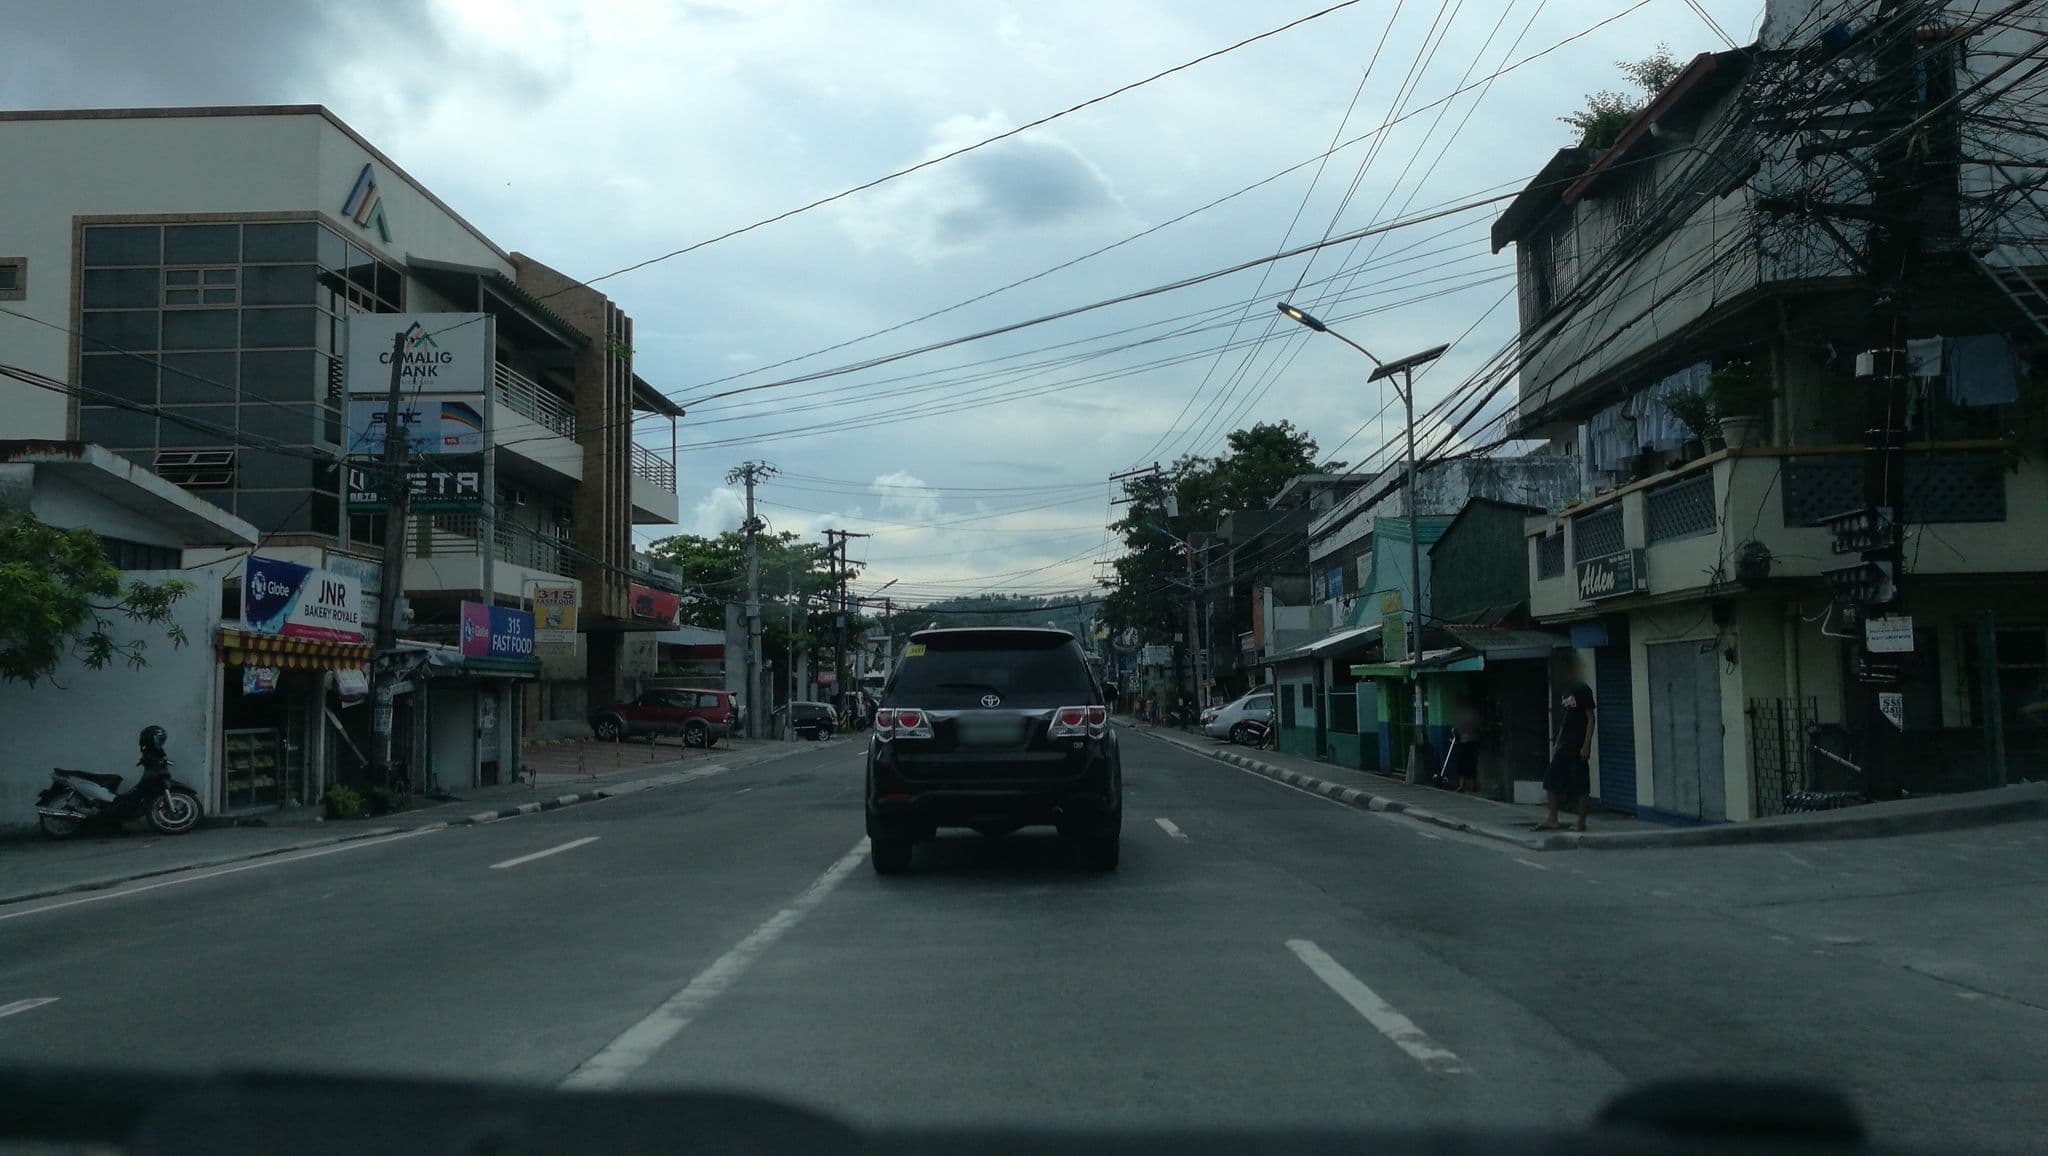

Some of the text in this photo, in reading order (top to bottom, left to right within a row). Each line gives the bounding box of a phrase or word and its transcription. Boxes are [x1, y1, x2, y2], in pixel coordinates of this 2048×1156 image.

[402, 365, 439, 377] ANK
[406, 472, 479, 495] ETA
[267, 581, 290, 597] Globe
[1580, 563, 1615, 600] Alden
[318, 579, 346, 608] JNR
[538, 590, 574, 599] 315
[304, 604, 358, 624] BAKERY ROYALE
[507, 616, 521, 636] 315
[492, 634, 511, 652] FAST
[511, 636, 533, 654] FOOD
